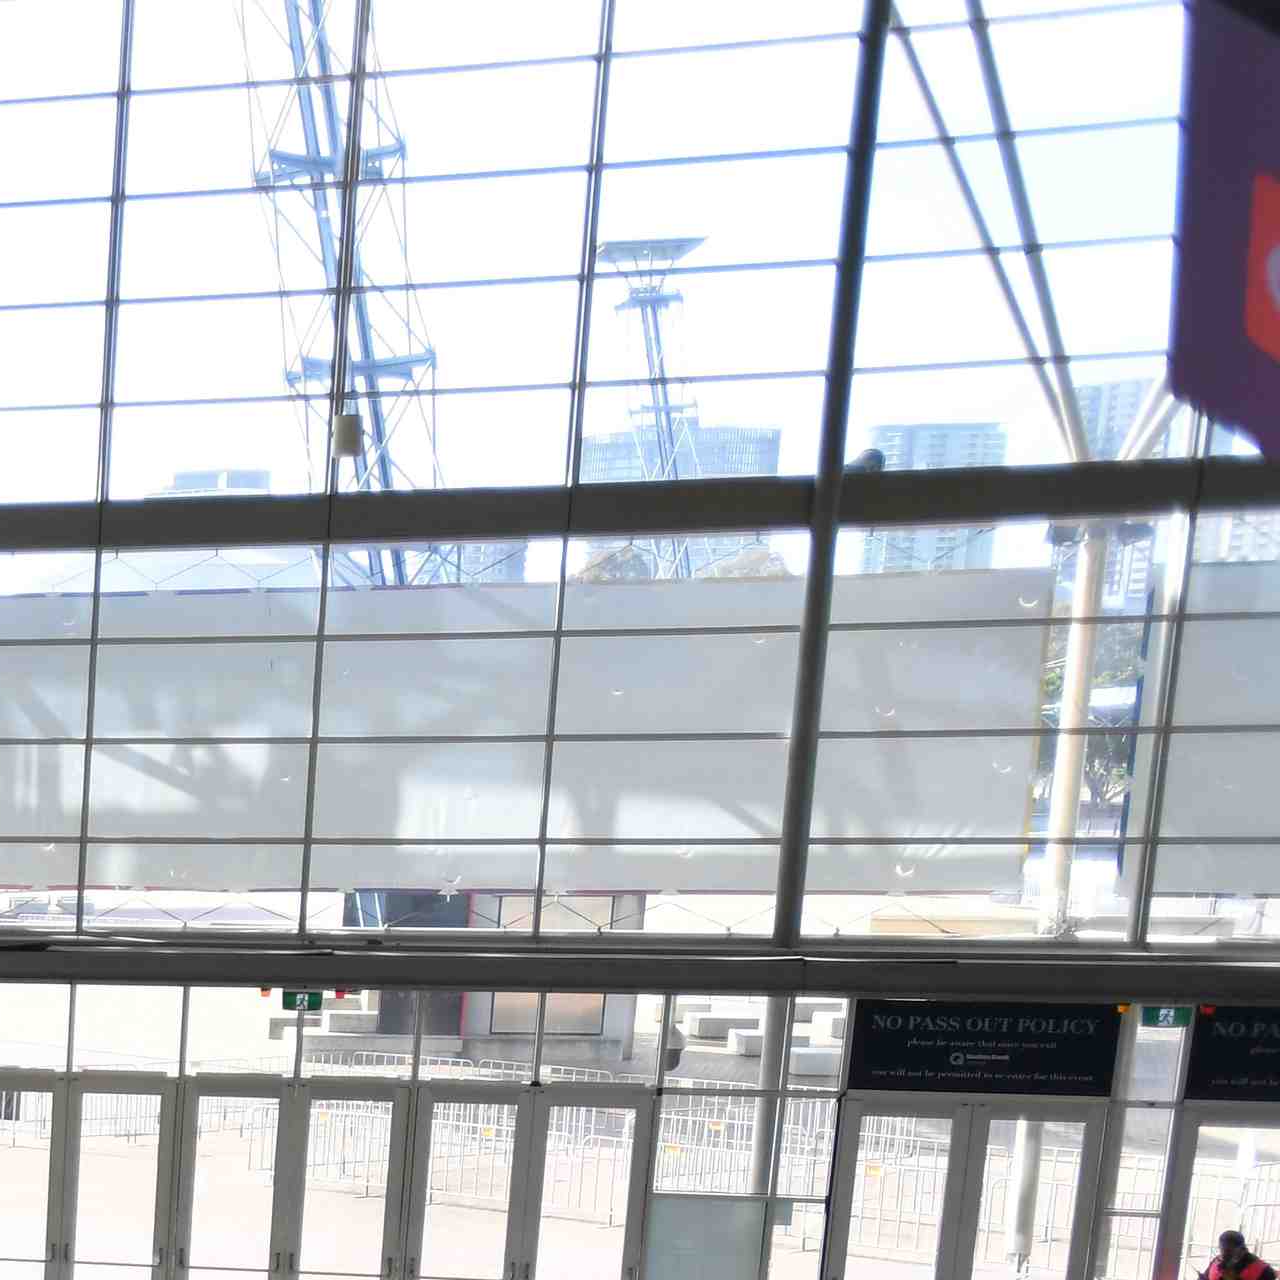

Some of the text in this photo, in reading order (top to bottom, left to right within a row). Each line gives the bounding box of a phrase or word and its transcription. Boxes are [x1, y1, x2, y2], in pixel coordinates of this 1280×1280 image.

[871, 1014, 1099, 1035] NO PASS OUT POLICY
